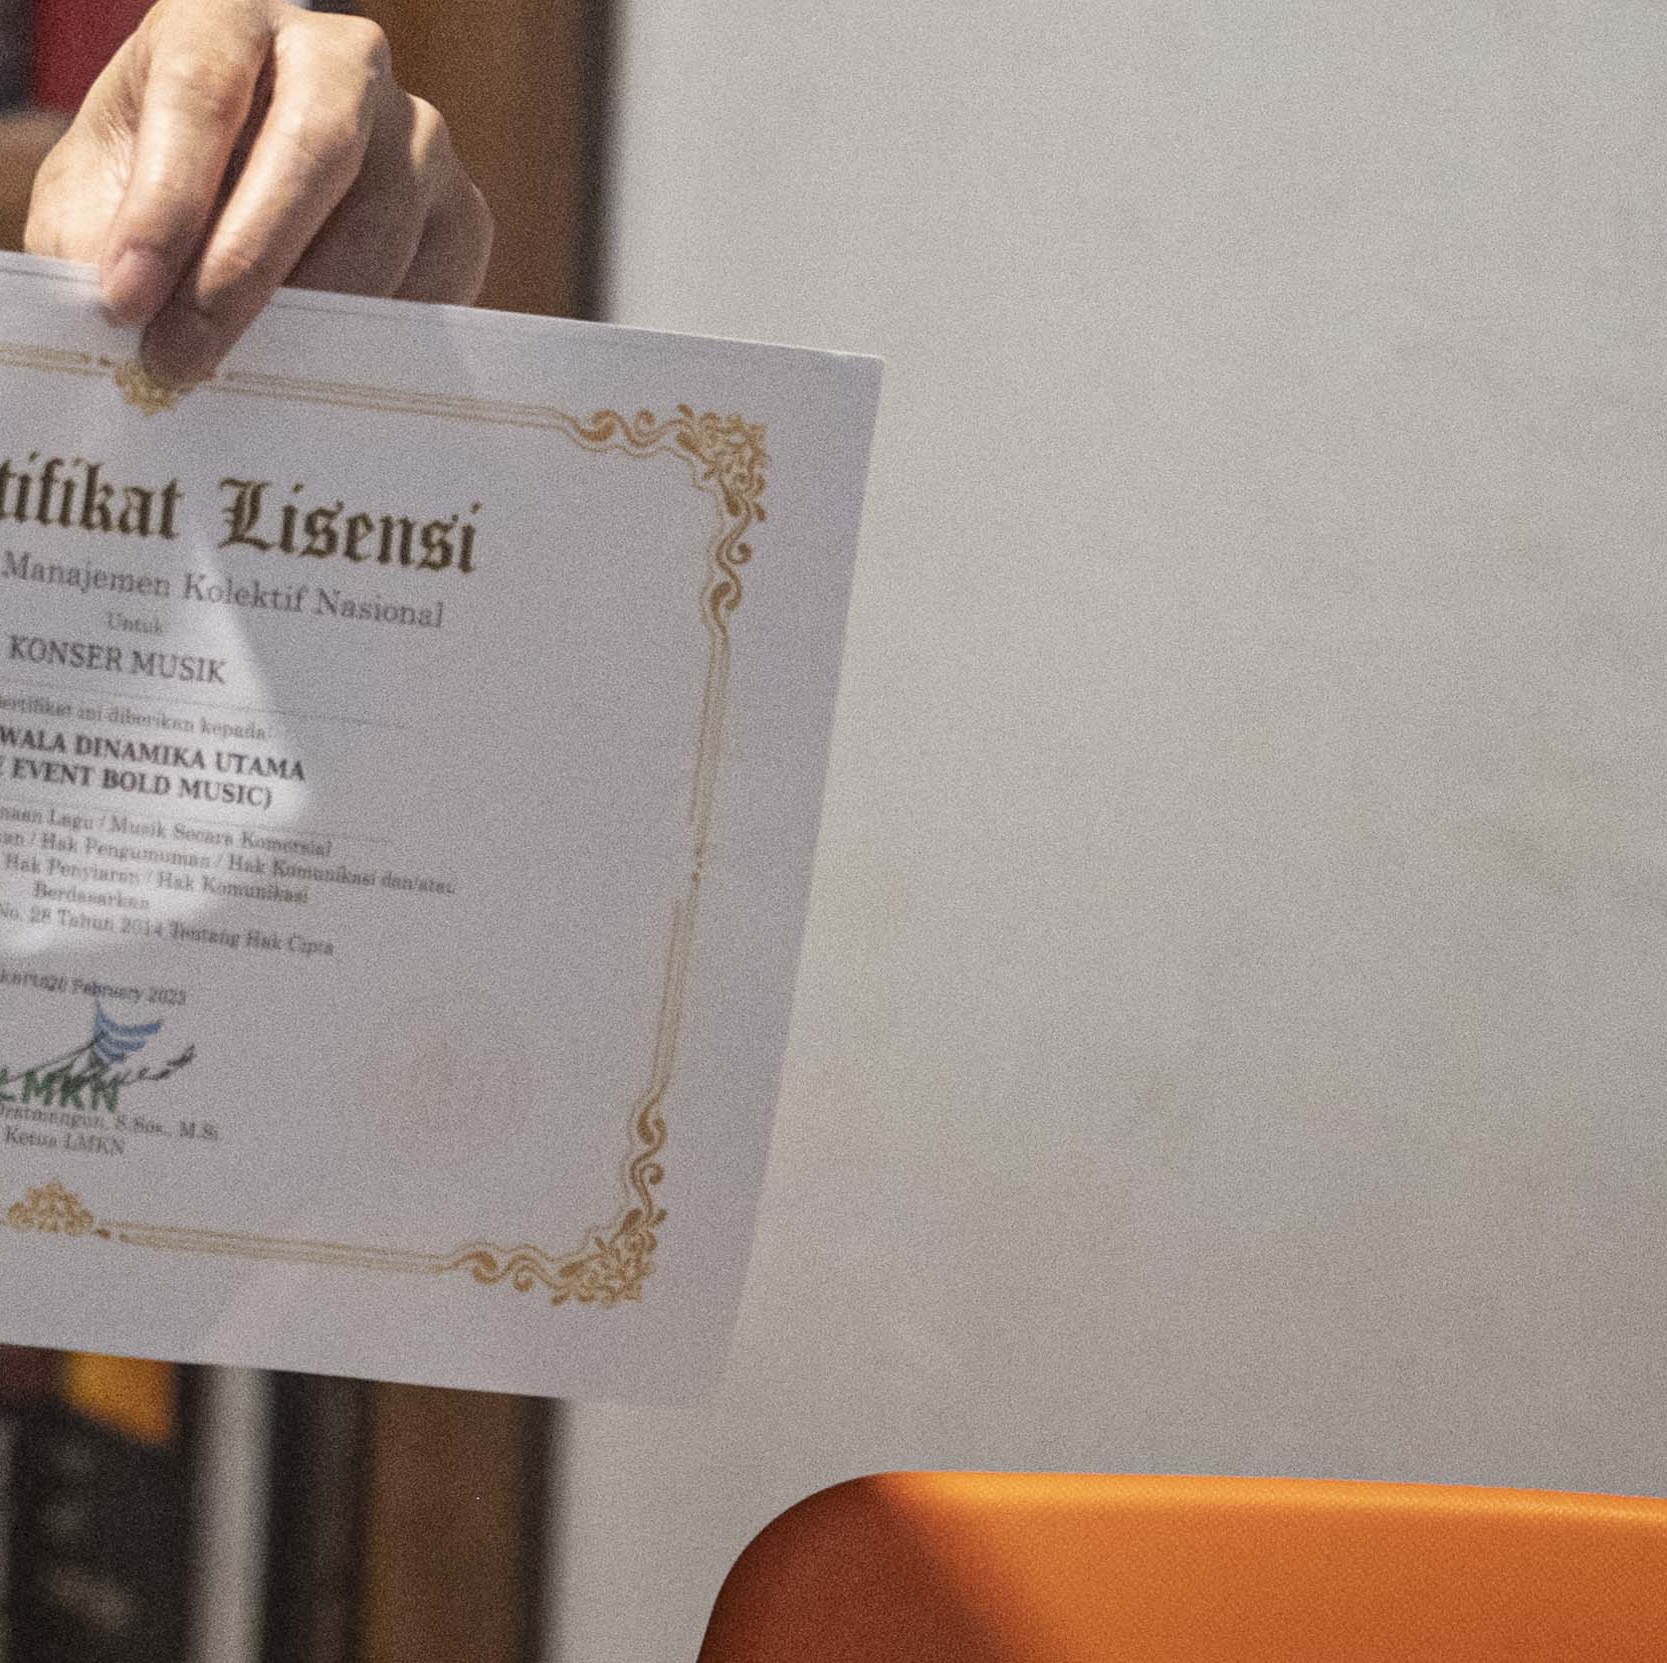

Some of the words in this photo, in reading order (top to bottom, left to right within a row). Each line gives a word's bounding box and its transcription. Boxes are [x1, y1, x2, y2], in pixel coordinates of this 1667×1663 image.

[213, 474, 482, 575] Lisensi
[2, 551, 172, 601] Manajemen
[183, 573, 308, 613] Kolektif
[316, 589, 444, 628] Nasional
[106, 614, 162, 635] Untuk
[8, 635, 123, 671] KONSER
[131, 651, 227, 684] MUSIK
[78, 704, 101, 720] ini
[108, 707, 194, 731] diberikan
[75, 735, 206, 768] DINAMIKA
[214, 751, 305, 780] UTAMA
[12, 757, 94, 786] EVENT
[102, 769, 170, 795] BOLD
[178, 778, 272, 810] MUSIC)
[48, 809, 93, 832] Lagu
[109, 816, 166, 837] Musik
[174, 824, 233, 844] Secara
[242, 832, 331, 856] Komersial
[5, 854, 41, 872] Hak
[157, 871, 194, 890] Hak
[201, 876, 308, 903] Komunikasi
[42, 832, 76, 852] Hak
[85, 838, 211, 870] Pengumuman
[228, 854, 265, 872] Hak
[273, 859, 375, 885] Komunikasi
[34, 881, 150, 909] Berdasarkan
[56, 909, 114, 930] Tahun
[246, 930, 280, 949] Hak
[288, 935, 334, 959] Cipta
[5, 1129, 57, 1148] Ketua
[64, 1136, 124, 1156] LMKN
